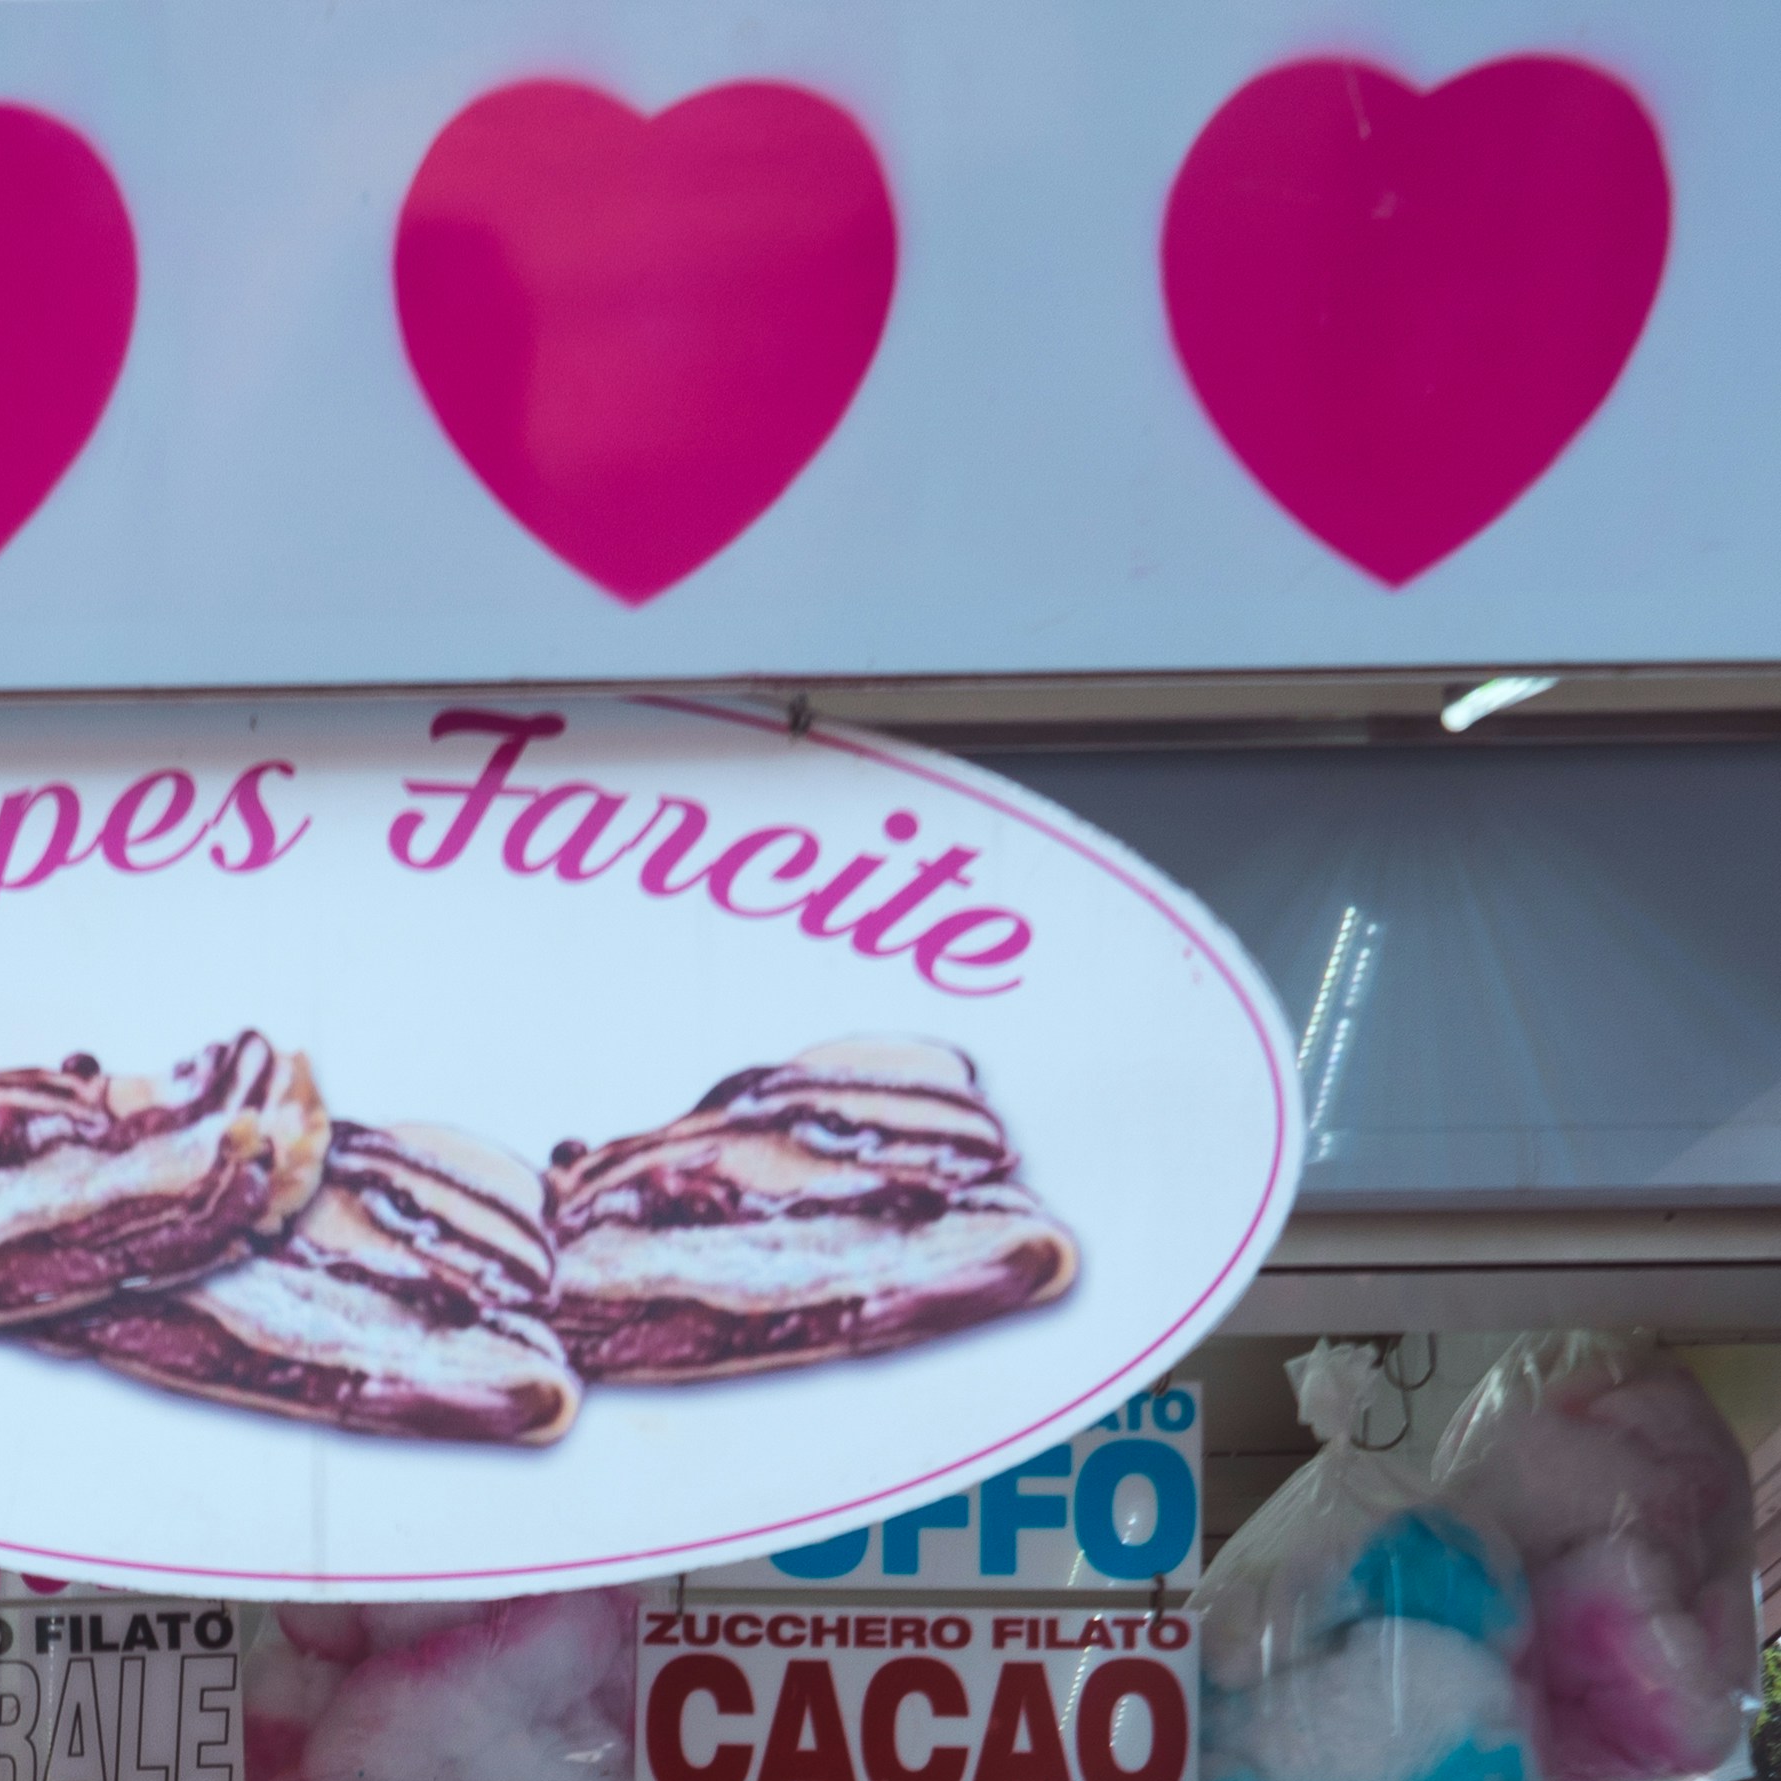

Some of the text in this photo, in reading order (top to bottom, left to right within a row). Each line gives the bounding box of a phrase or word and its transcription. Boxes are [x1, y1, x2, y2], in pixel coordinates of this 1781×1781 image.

[387, 708, 1034, 998] Farcite
[35, 1611, 234, 1655] FILATO
[644, 1612, 1192, 1652] ZUCCHERO FILATO
